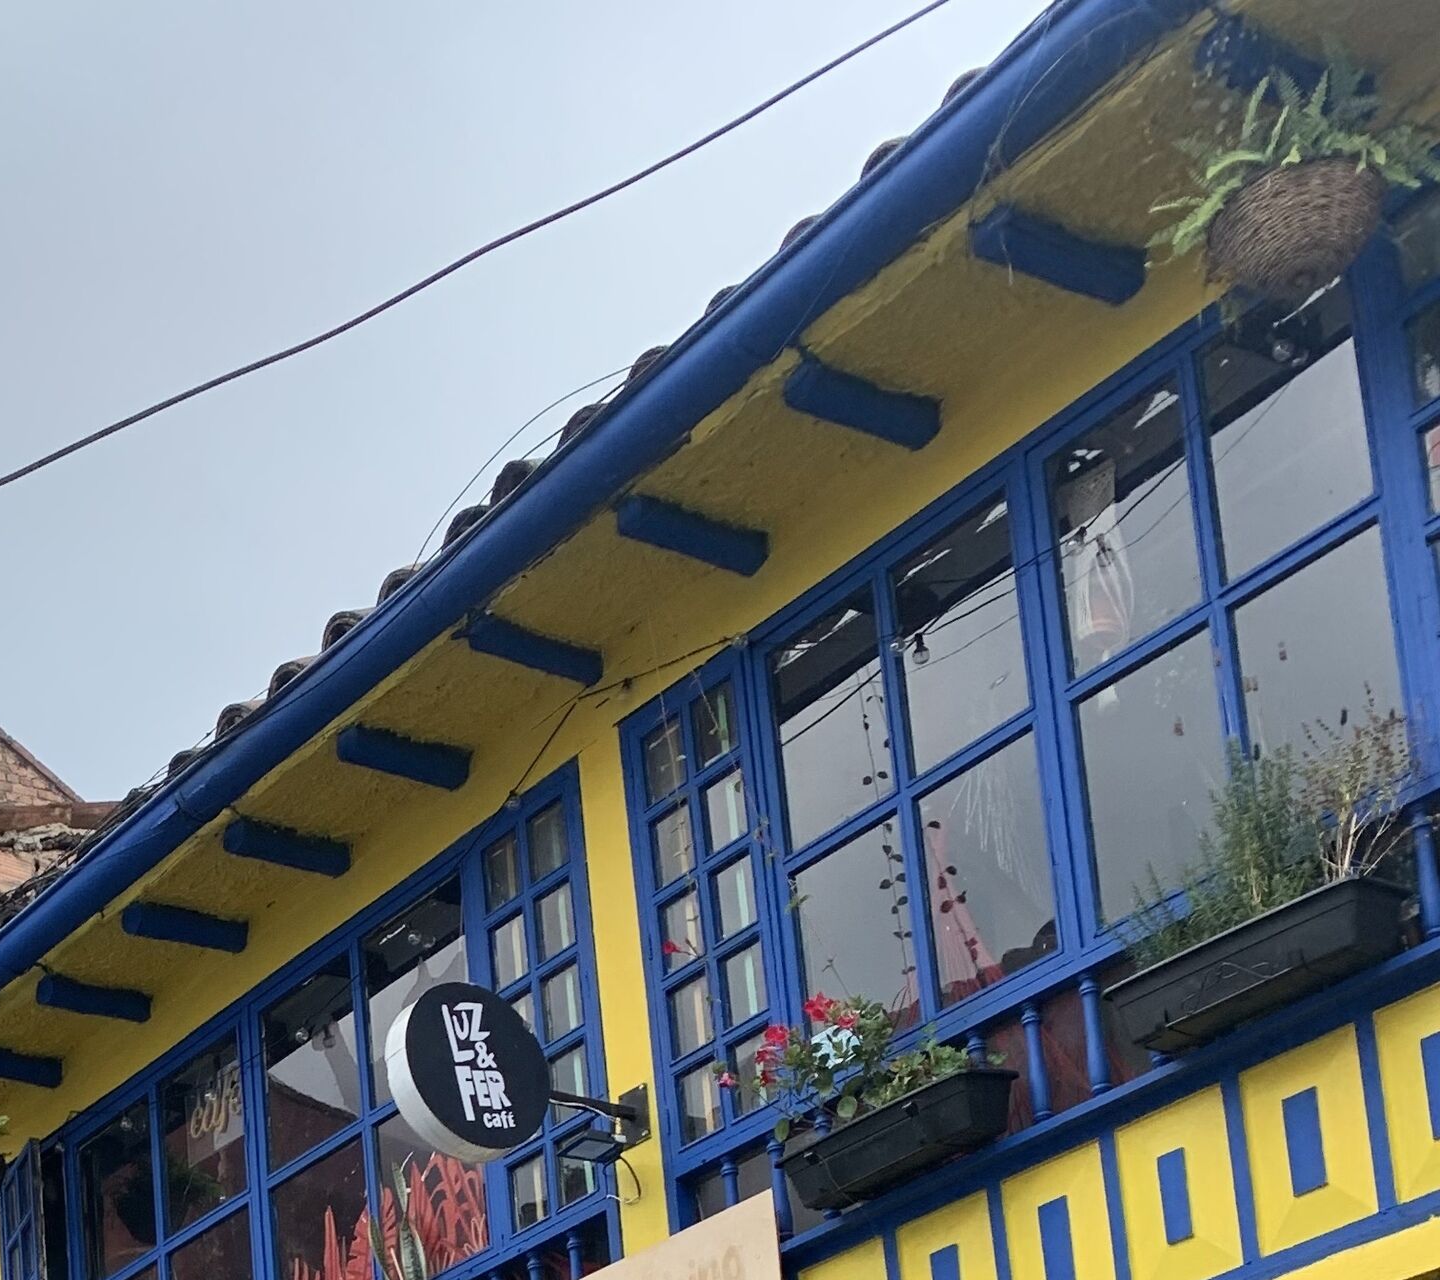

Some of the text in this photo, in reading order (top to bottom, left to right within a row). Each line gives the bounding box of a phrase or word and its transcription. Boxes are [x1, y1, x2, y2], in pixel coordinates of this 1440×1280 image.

[441, 1002, 491, 1063] LUZ
[474, 1041, 498, 1069] &
[454, 1065, 512, 1121] FER
